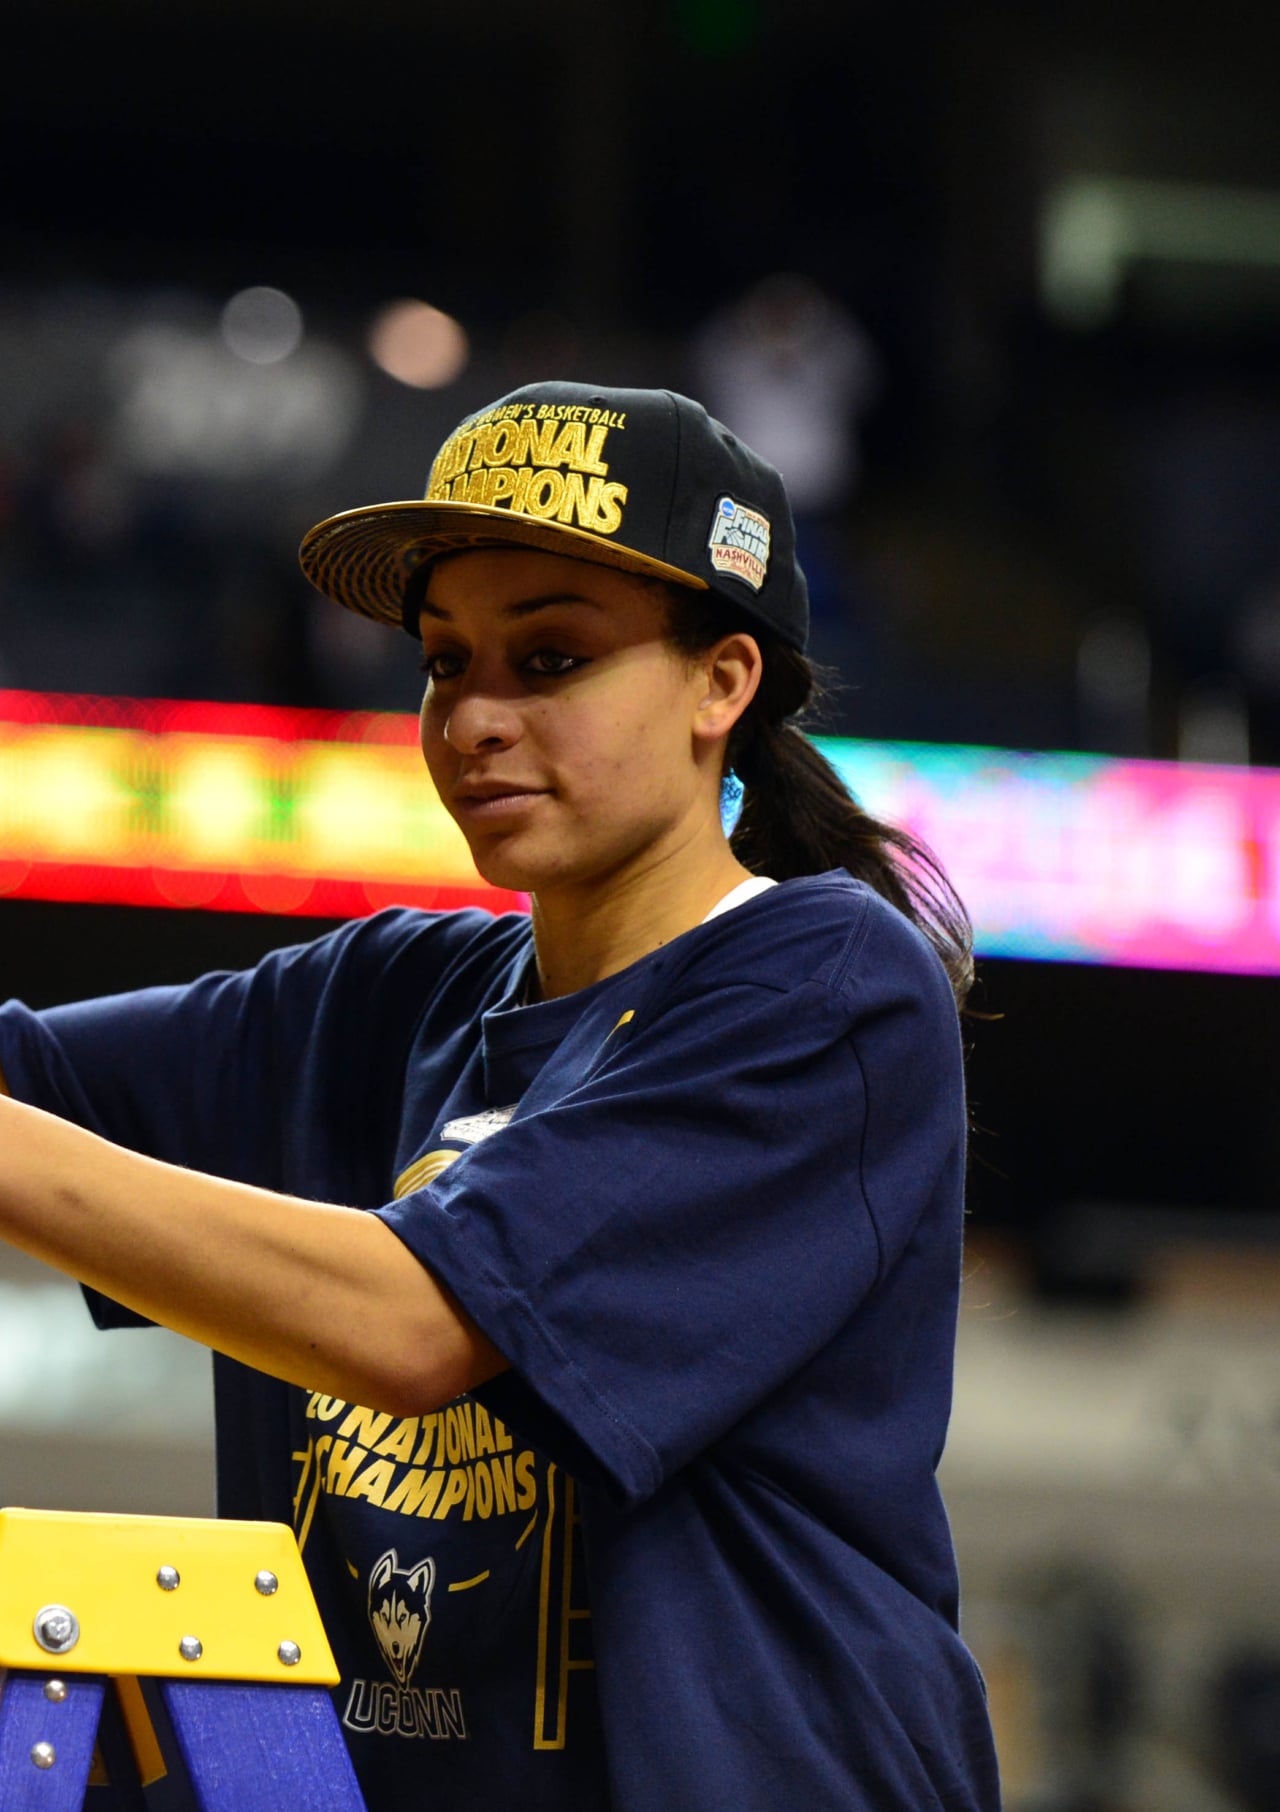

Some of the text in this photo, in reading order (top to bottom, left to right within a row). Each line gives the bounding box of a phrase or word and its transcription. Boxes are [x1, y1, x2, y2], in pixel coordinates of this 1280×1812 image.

[536, 403, 627, 430] BASKETBALL
[425, 466, 629, 535] AMPIONS
[337, 1401, 513, 1468] NATIONAL
[315, 1434, 536, 1522] CHAMPIONS
[342, 1678, 467, 1740] UCONN
